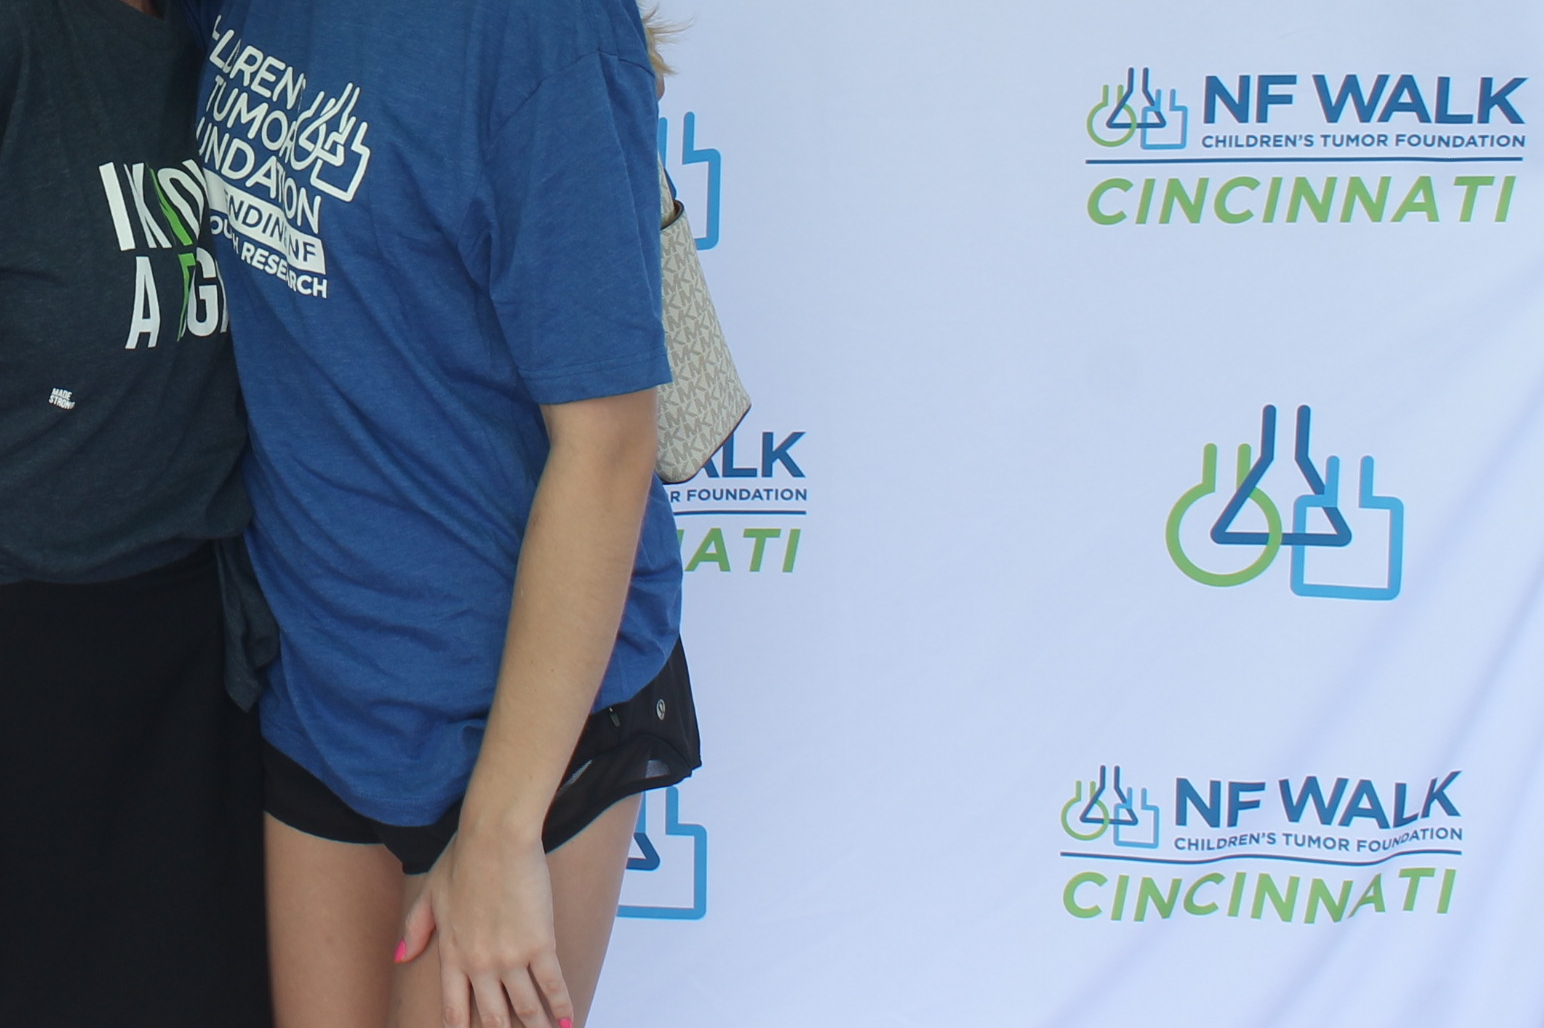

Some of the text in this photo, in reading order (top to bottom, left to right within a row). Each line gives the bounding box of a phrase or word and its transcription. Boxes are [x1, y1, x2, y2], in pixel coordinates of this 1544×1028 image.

[1203, 74, 1529, 124] NF WALK
[1320, 134, 1388, 148] TUMOR
[1395, 134, 1525, 149] FOUNDATION
[99, 162, 136, 251] I
[1086, 175, 1516, 226] CINCINNATI
[125, 256, 161, 349] A
[687, 488, 807, 502] FOUNDATION
[1175, 770, 1462, 829] NF WALK
[1284, 833, 1350, 853] TUMOR
[1356, 827, 1463, 853] FOUNDATION
[1063, 867, 1457, 924] CINCINNATI
